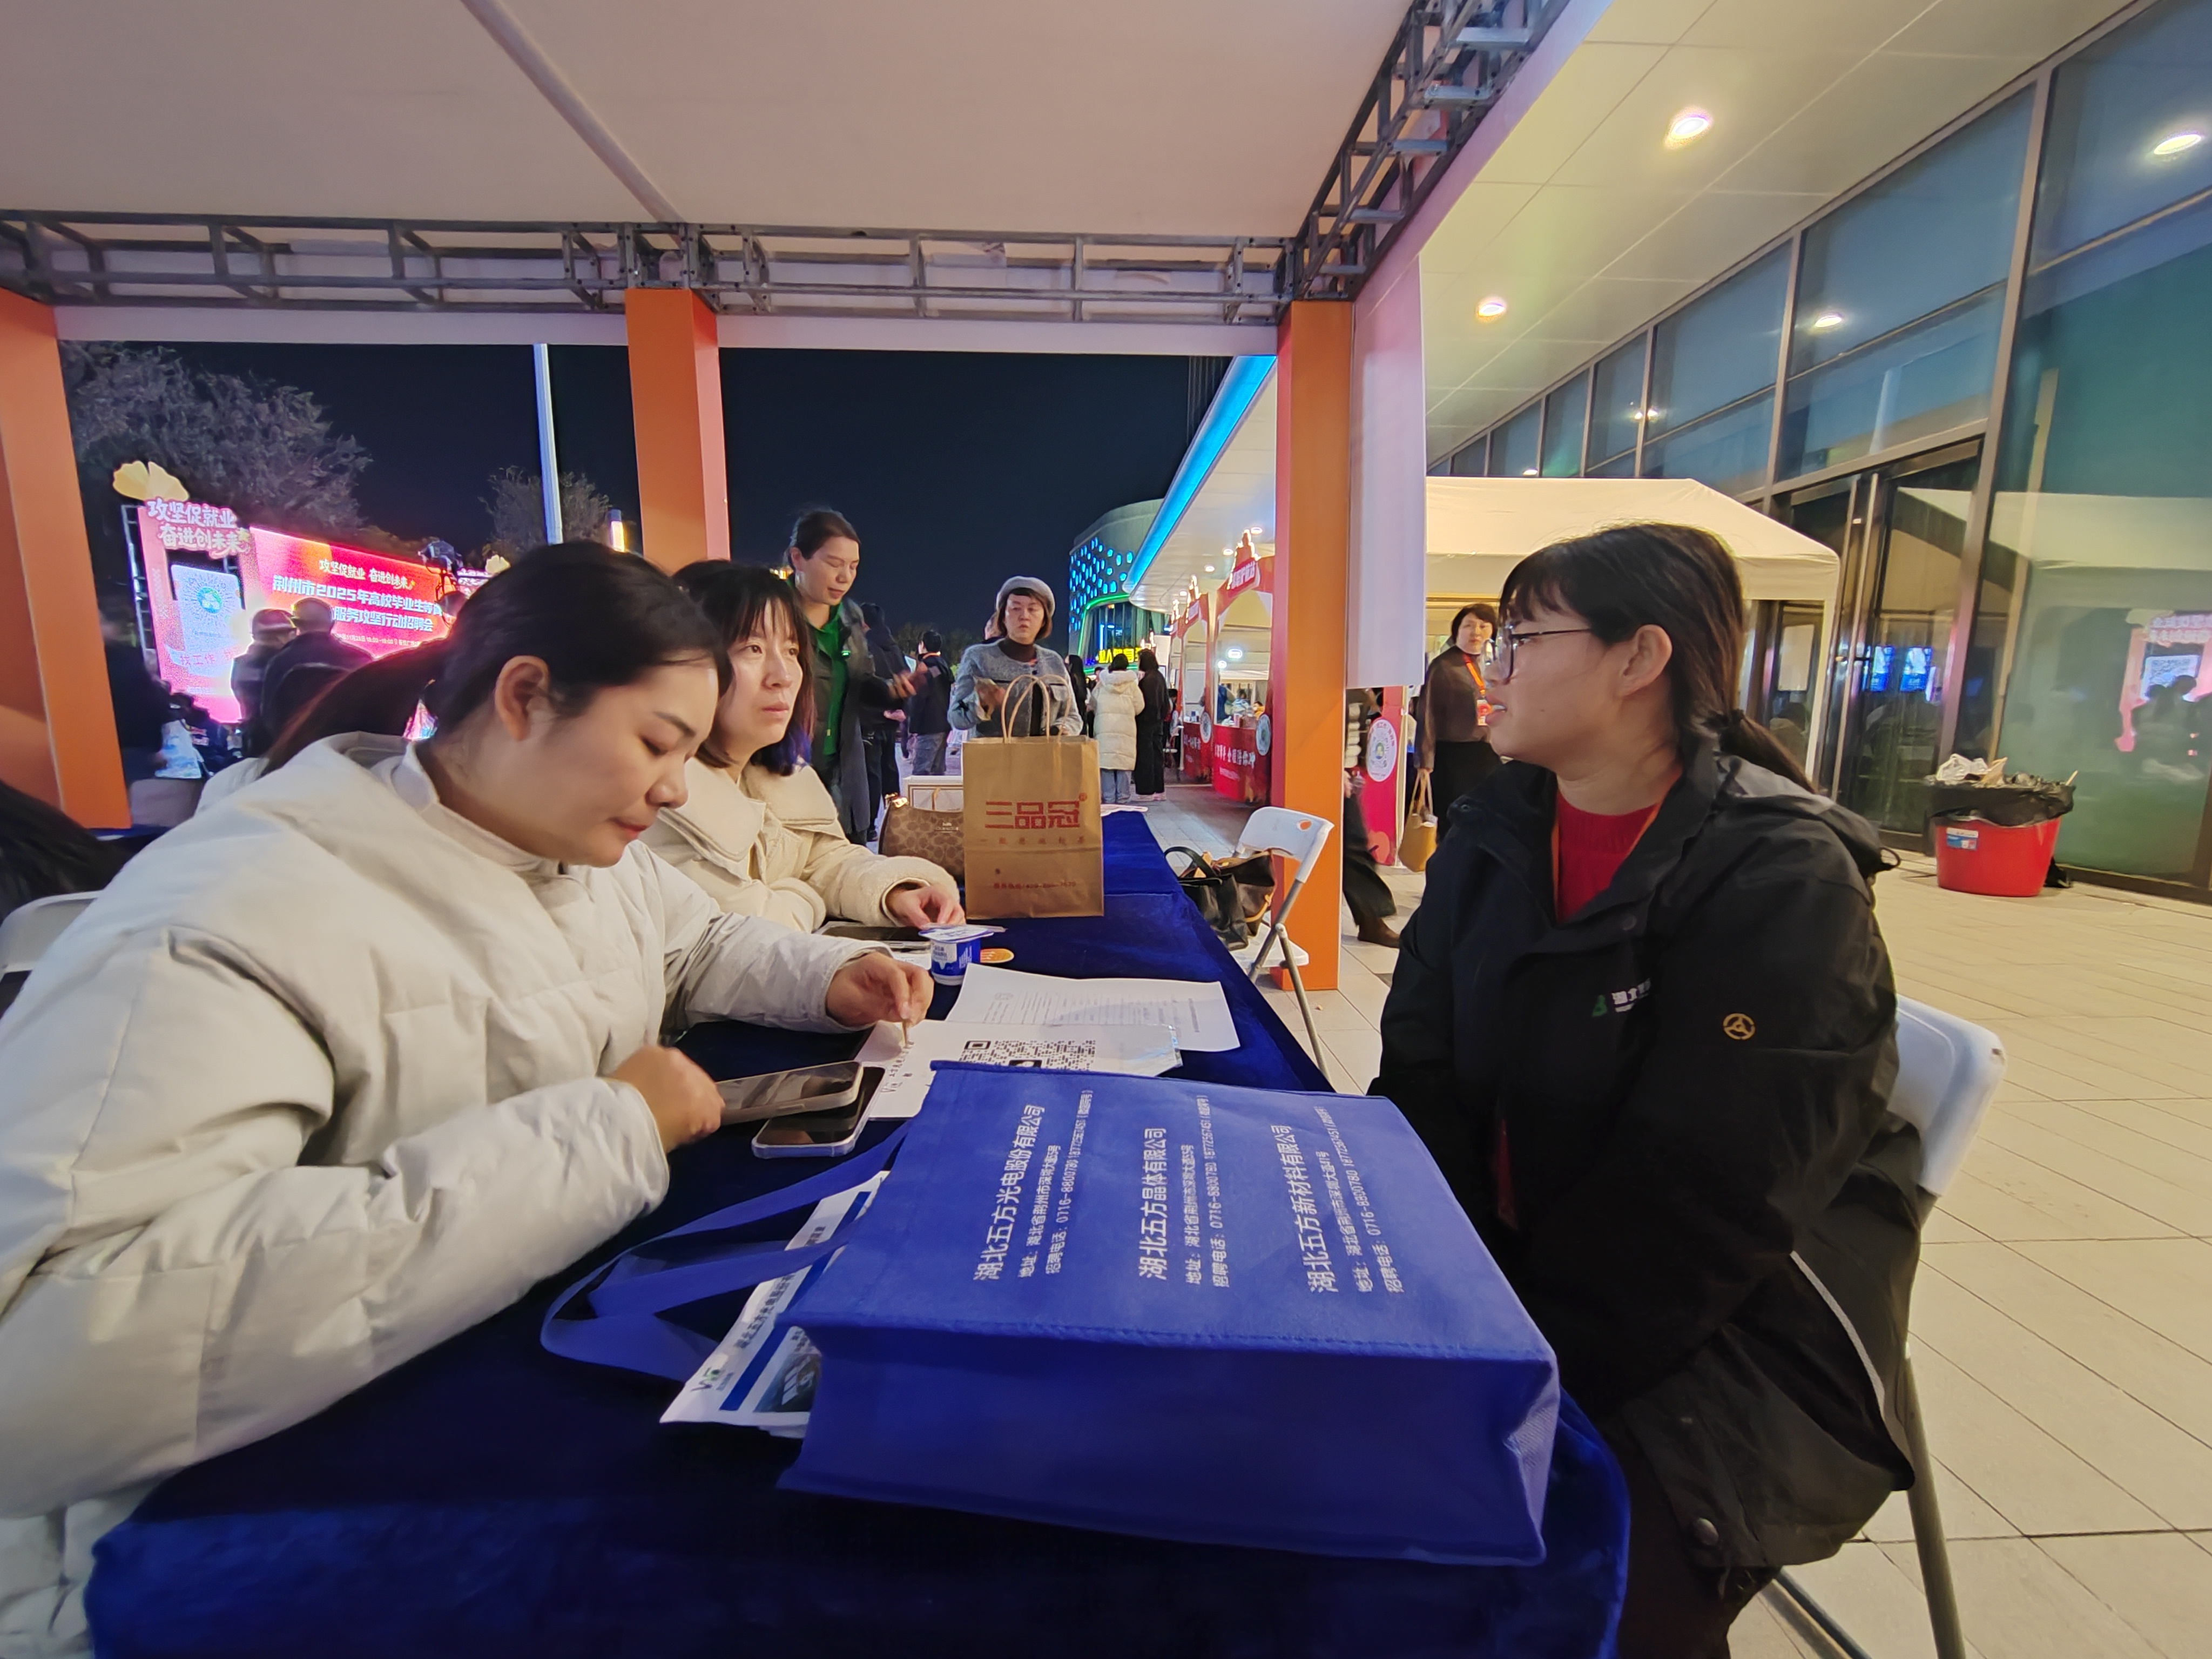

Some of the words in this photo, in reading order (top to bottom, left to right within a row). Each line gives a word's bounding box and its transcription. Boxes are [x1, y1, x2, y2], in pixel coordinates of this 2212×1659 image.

[147, 497, 238, 529] 攻坚促就业
[159, 522, 248, 556] 奋进创未来
[319, 558, 366, 580] 攻坚促就业
[368, 568, 413, 590] 奋进创未来
[984, 800, 1080, 830] 三品冠
[973, 1104, 1045, 1280] 湖北五方光电股份有限公司
[1138, 1127, 1168, 1281] 湖北五方晶体有限公司
[1270, 1124, 1339, 1293] 湖北五方新材料有限公司
